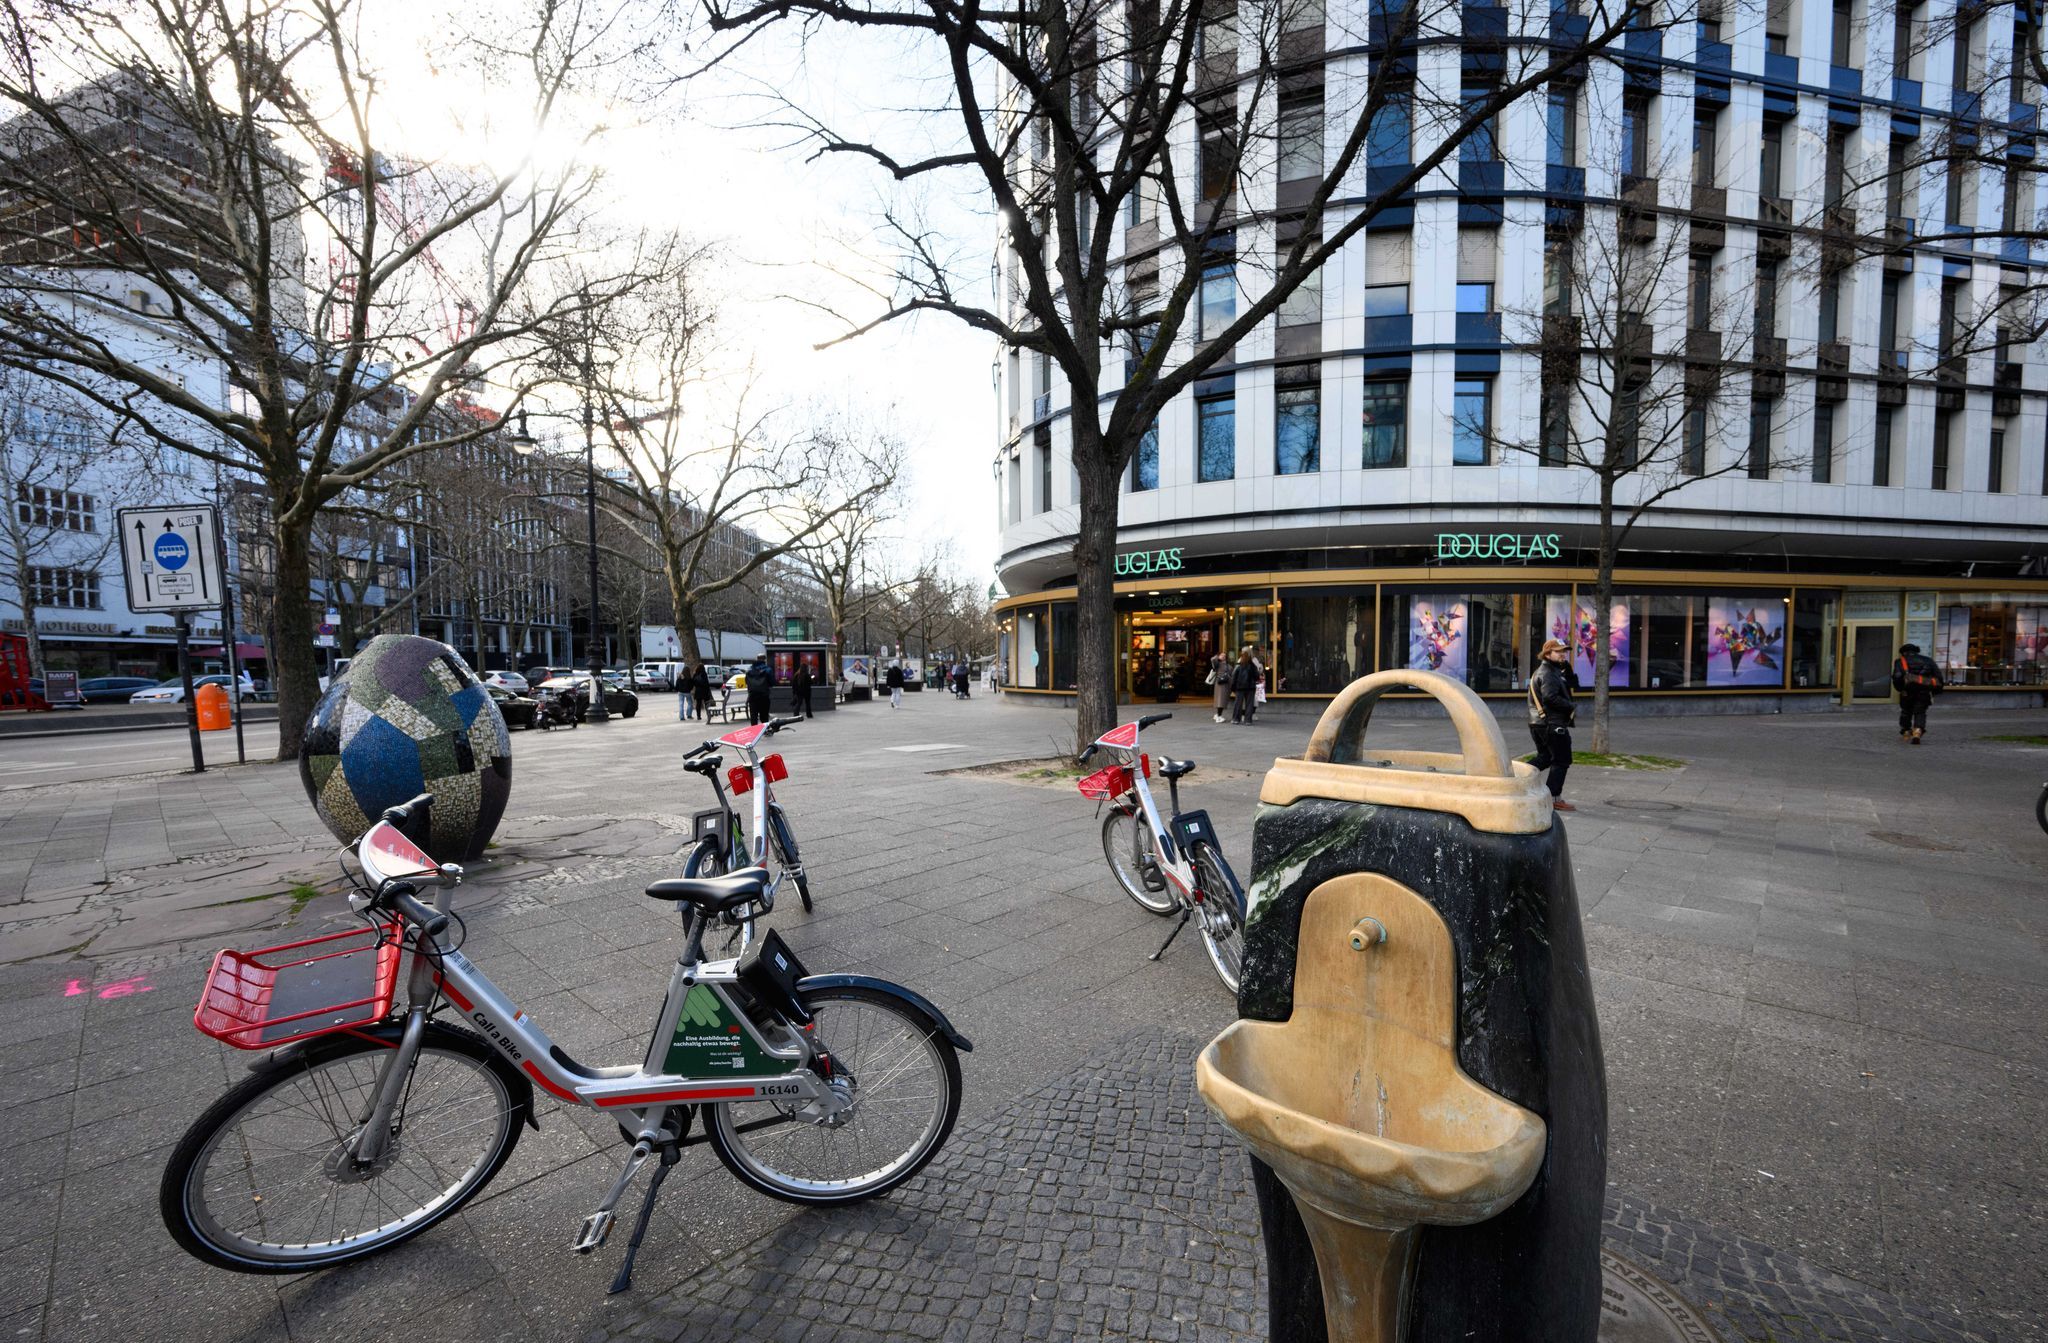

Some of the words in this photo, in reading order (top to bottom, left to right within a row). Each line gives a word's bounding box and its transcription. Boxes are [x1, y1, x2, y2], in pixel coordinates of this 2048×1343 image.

[1438, 533, 1560, 558] DOUGLAS
[1114, 548, 1182, 575] UGLAS
[1149, 596, 1184, 607] DOUGLAS
[1911, 600, 1929, 612] 33
[2, 619, 118, 634] BIIOTHEQUE
[473, 1012, 496, 1033] Call
[490, 1031, 500, 1039] a
[497, 1036, 522, 1060] Bike
[760, 1085, 799, 1095] 16140
[1601, 1255, 1711, 1343] INKBRU
